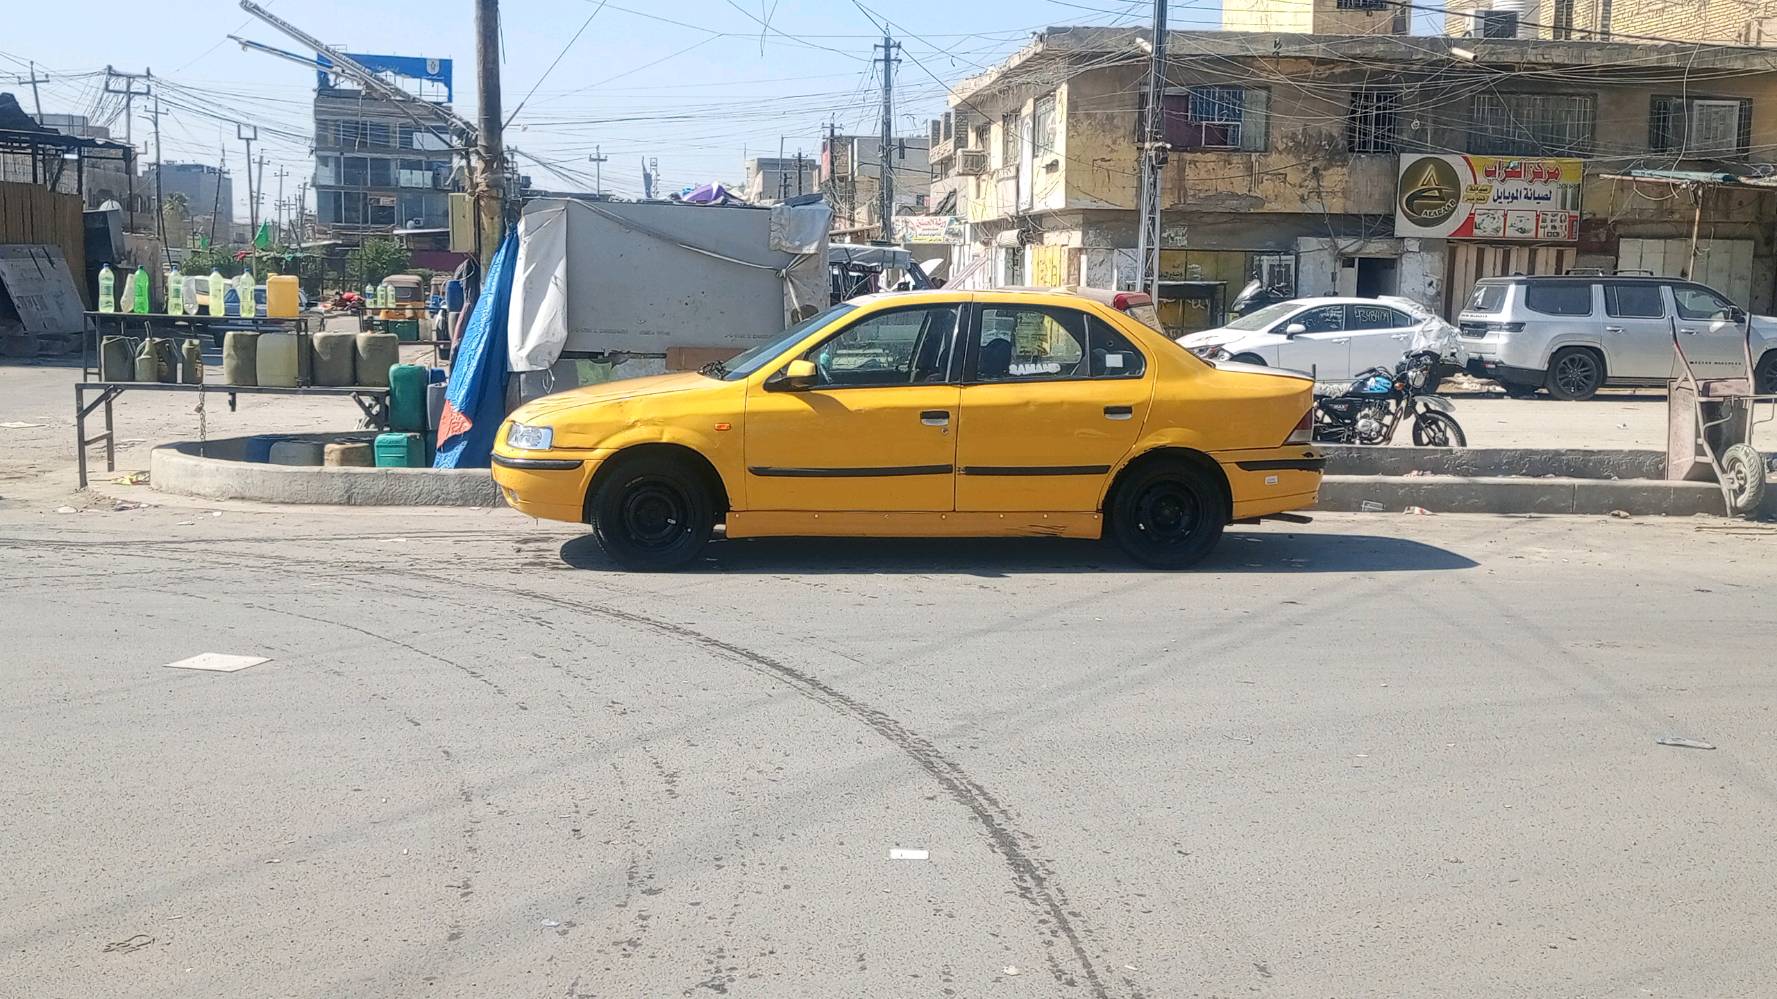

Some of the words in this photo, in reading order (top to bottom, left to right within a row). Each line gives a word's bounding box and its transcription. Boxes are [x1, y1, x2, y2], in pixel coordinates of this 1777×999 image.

[1527, 158, 1562, 184] مركز
[1492, 187, 1522, 205] الموبايل
[1523, 187, 1553, 205] لصيانة
